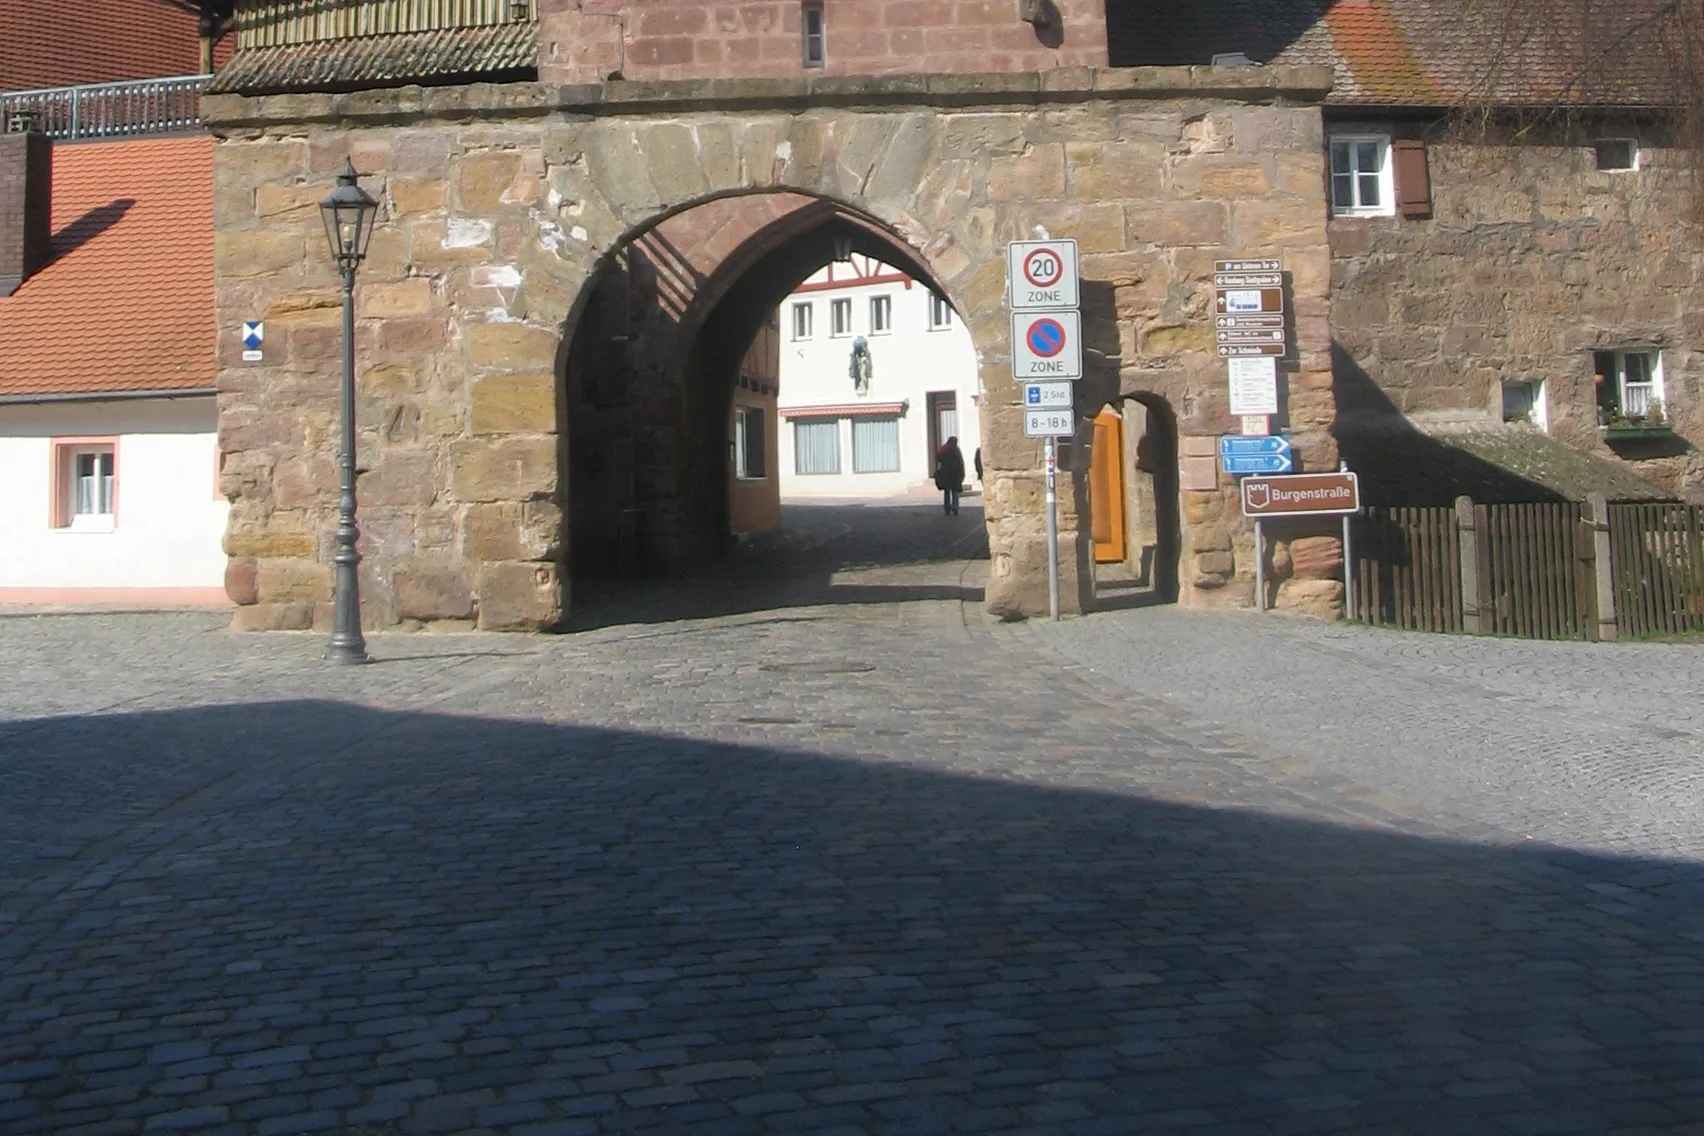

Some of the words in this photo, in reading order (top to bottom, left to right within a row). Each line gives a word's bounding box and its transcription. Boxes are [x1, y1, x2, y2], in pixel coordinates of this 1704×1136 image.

[1031, 259, 1055, 277] 20
[1028, 291, 1061, 302] ZONE
[1030, 361, 1064, 373] ZONE
[1043, 390, 1049, 399] 2
[1061, 417, 1068, 427] h
[1272, 486, 1351, 502] Burgenstraße
